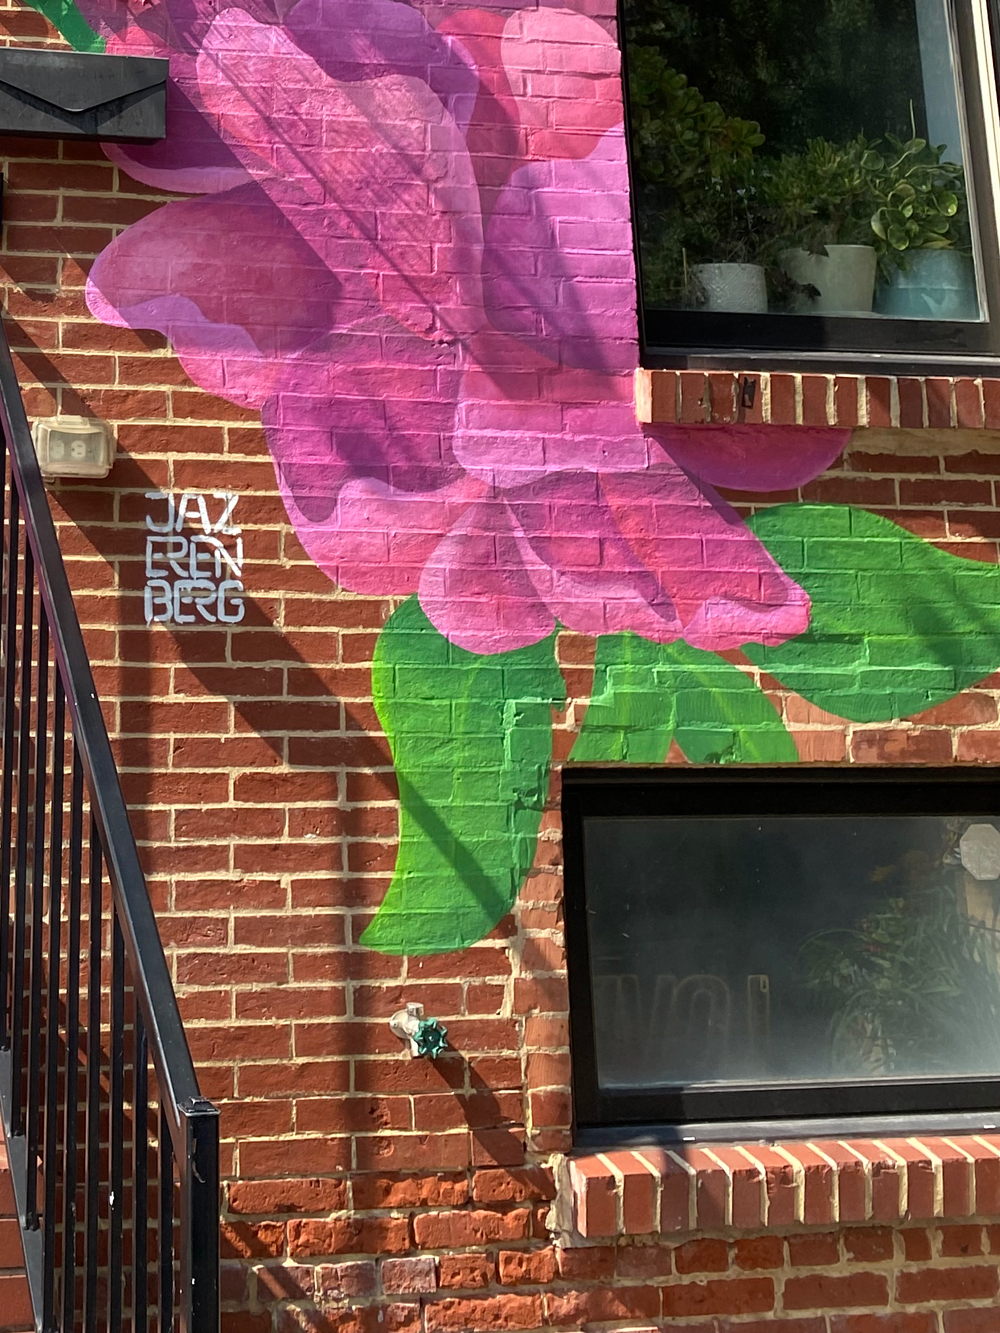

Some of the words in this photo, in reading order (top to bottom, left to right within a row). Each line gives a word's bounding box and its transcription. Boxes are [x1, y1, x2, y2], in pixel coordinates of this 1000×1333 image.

[145, 492, 242, 535] JAZ
[146, 534, 243, 578] EREN
[144, 579, 245, 627] BERG
